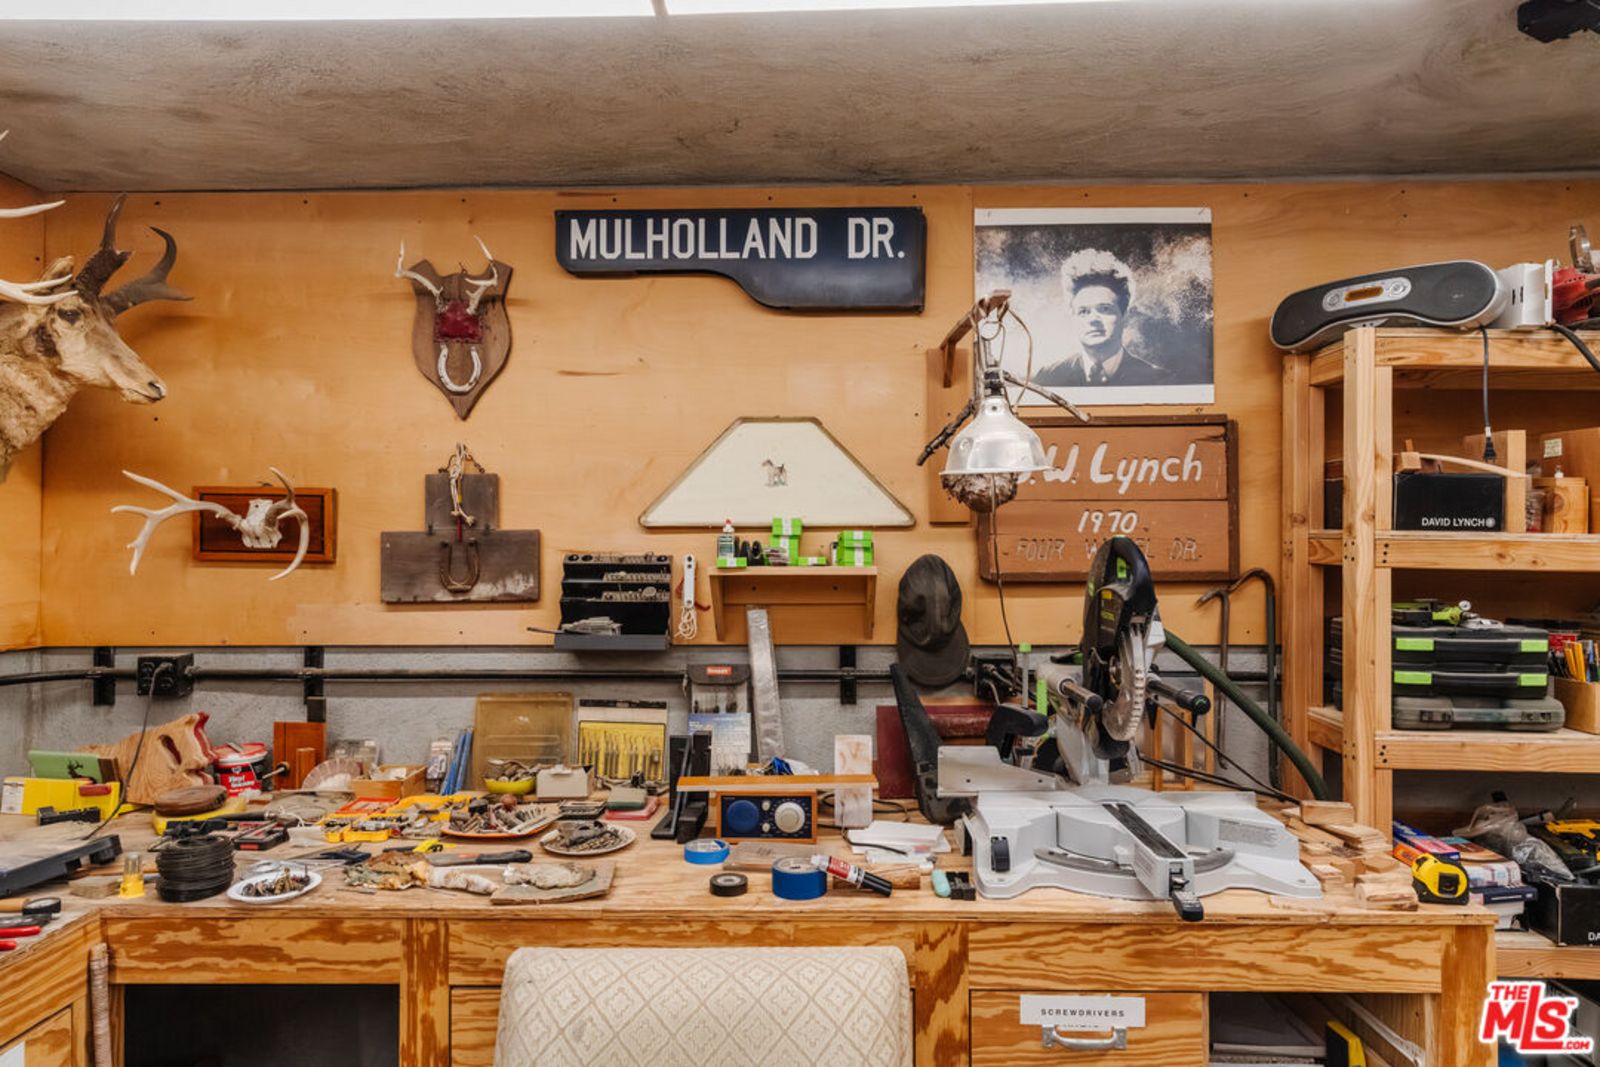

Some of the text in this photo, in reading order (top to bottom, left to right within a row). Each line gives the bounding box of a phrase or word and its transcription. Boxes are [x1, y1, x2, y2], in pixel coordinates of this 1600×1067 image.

[569, 216, 906, 260] MULHOLLAND DR.
[1089, 442, 1203, 495] Lynch
[1077, 510, 1139, 535] 1970
[1421, 516, 1485, 527] DAVID LYNCH
[1017, 538, 1065, 561] FOUR
[1040, 1008, 1125, 1018] SCREWDRIVERS
